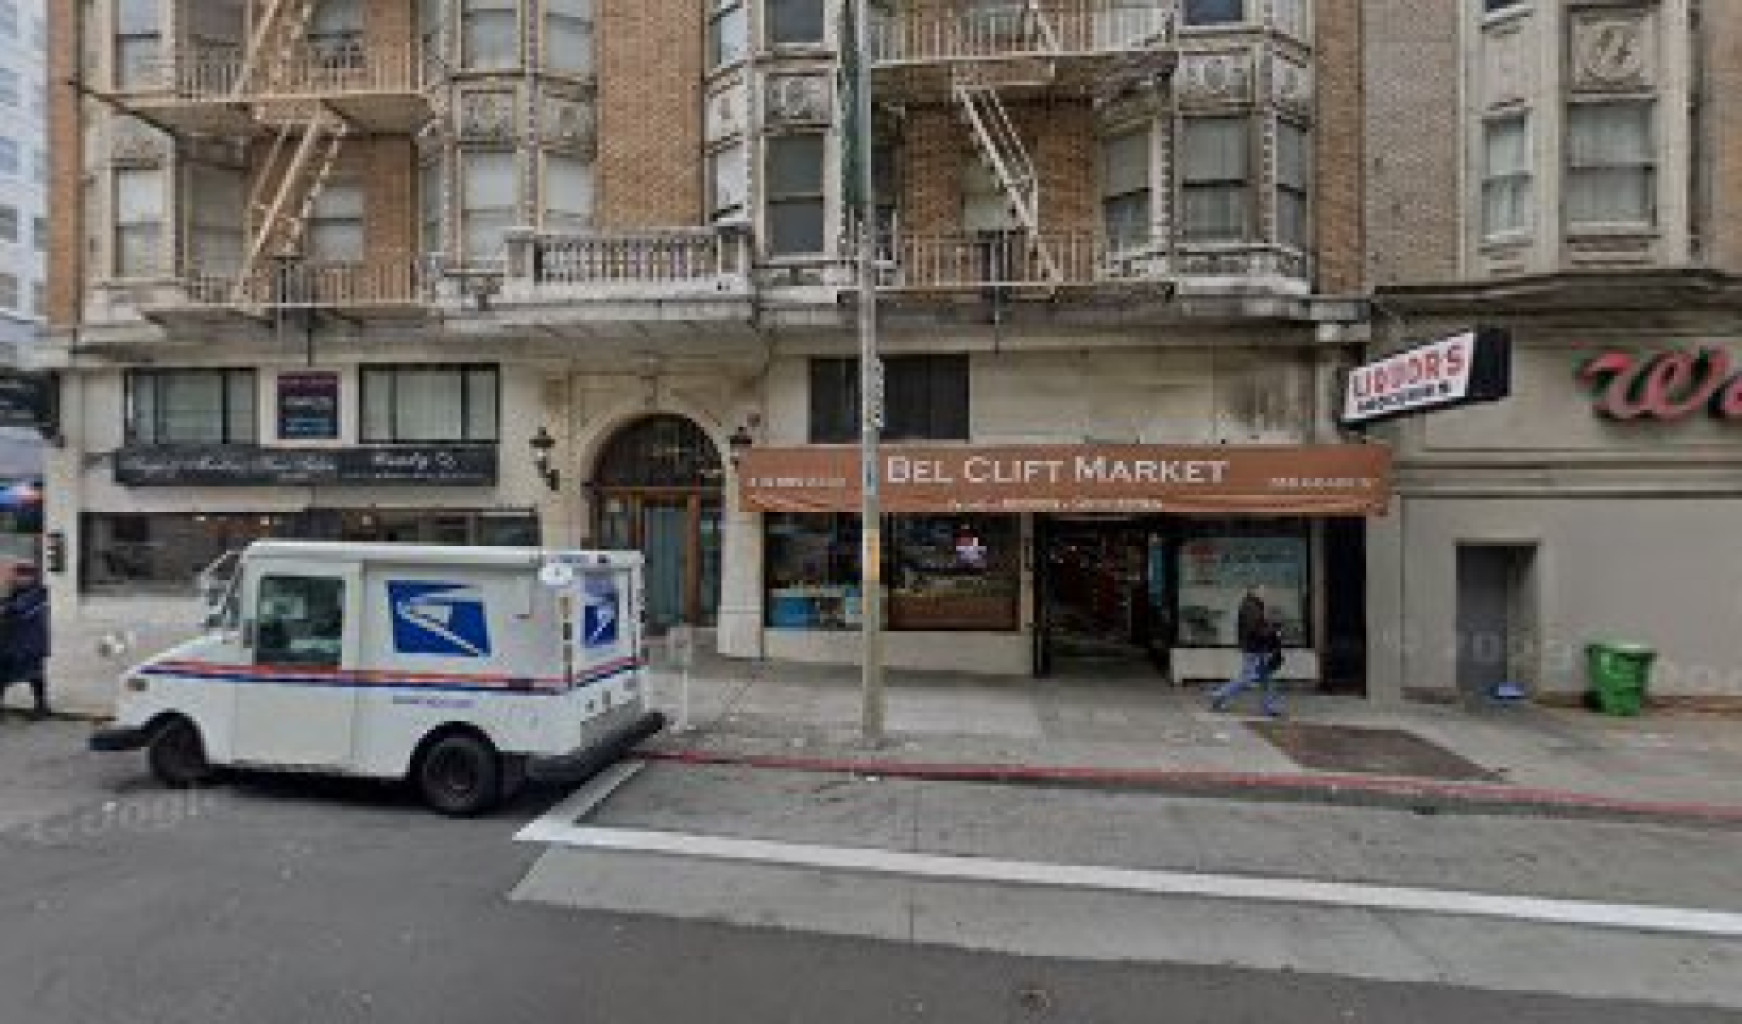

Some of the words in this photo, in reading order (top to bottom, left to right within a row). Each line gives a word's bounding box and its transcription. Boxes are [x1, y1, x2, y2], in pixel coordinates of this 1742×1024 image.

[1353, 343, 1466, 397] LIQUORS
[887, 455, 953, 484] BEL
[963, 455, 1064, 484] CLIFT
[1074, 455, 1230, 484] MARKET
